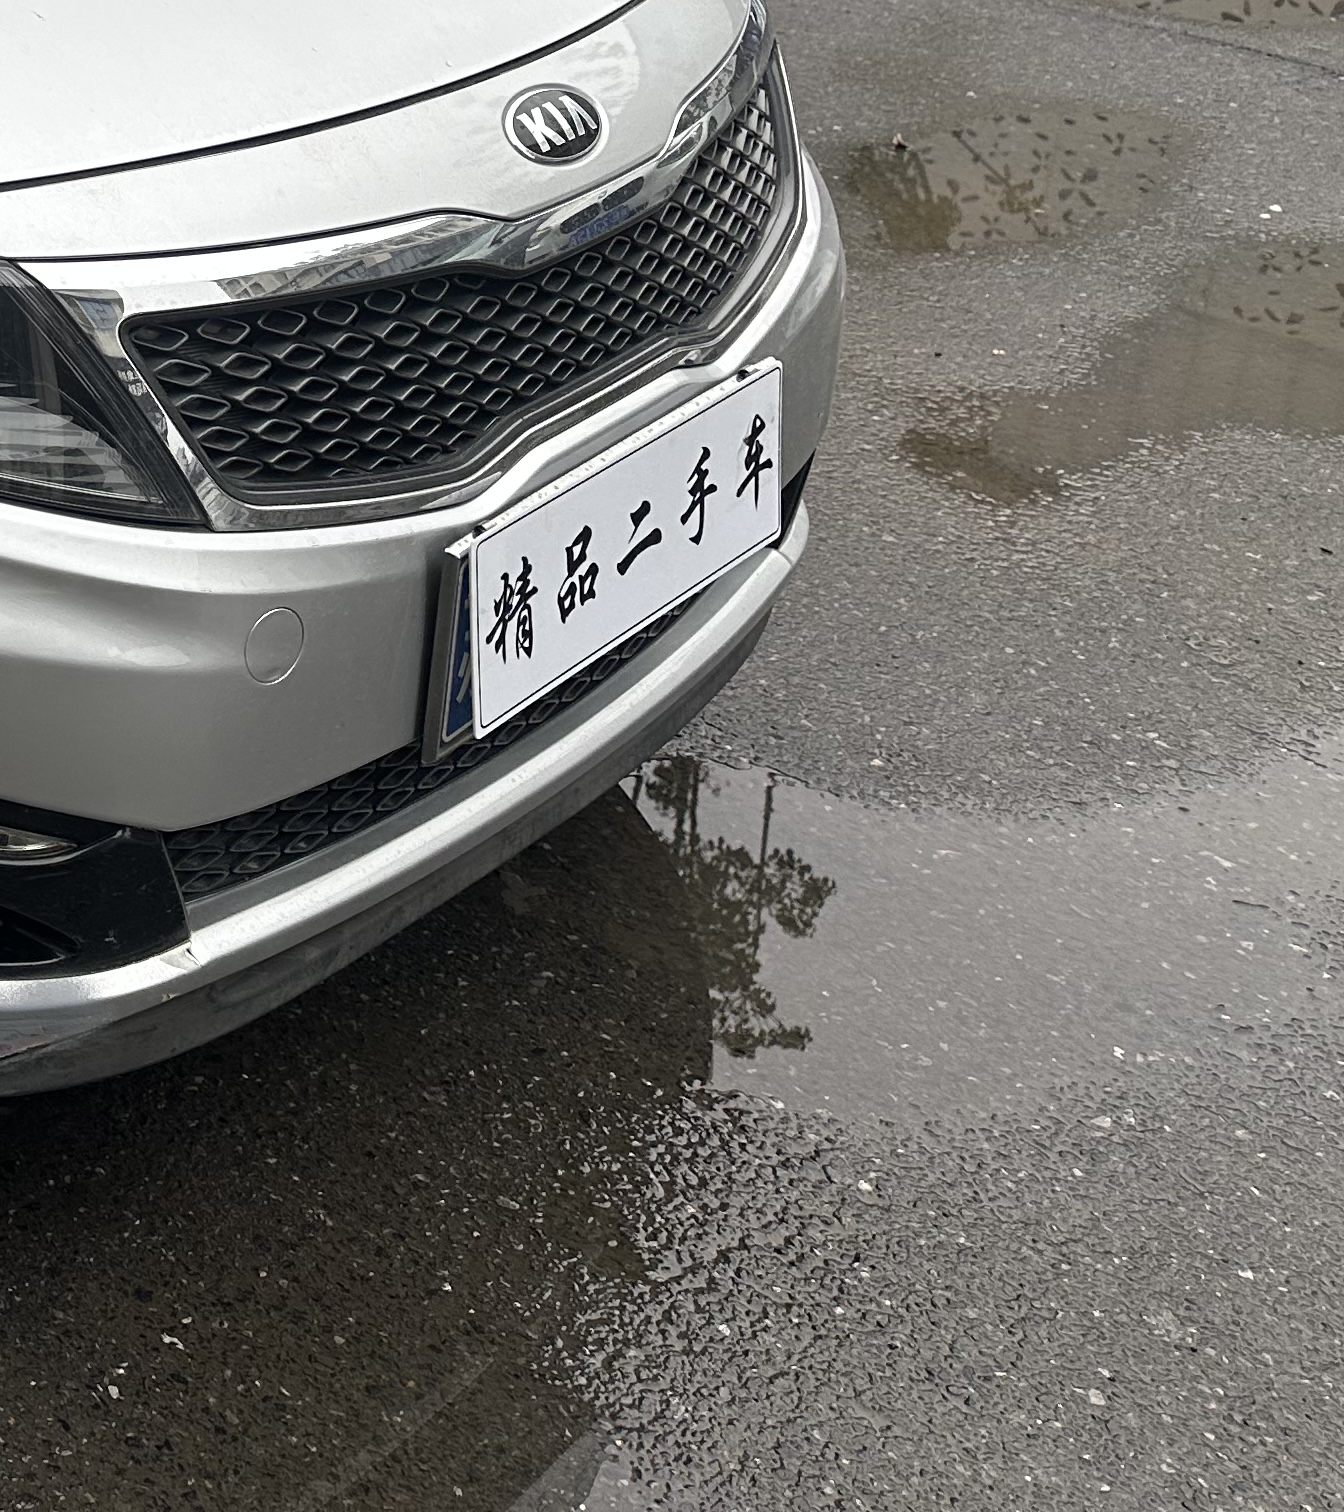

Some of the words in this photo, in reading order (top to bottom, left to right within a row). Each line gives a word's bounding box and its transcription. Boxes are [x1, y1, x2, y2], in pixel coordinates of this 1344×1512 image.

[516, 95, 598, 152] KIA
[485, 414, 773, 664] 精品二手车
